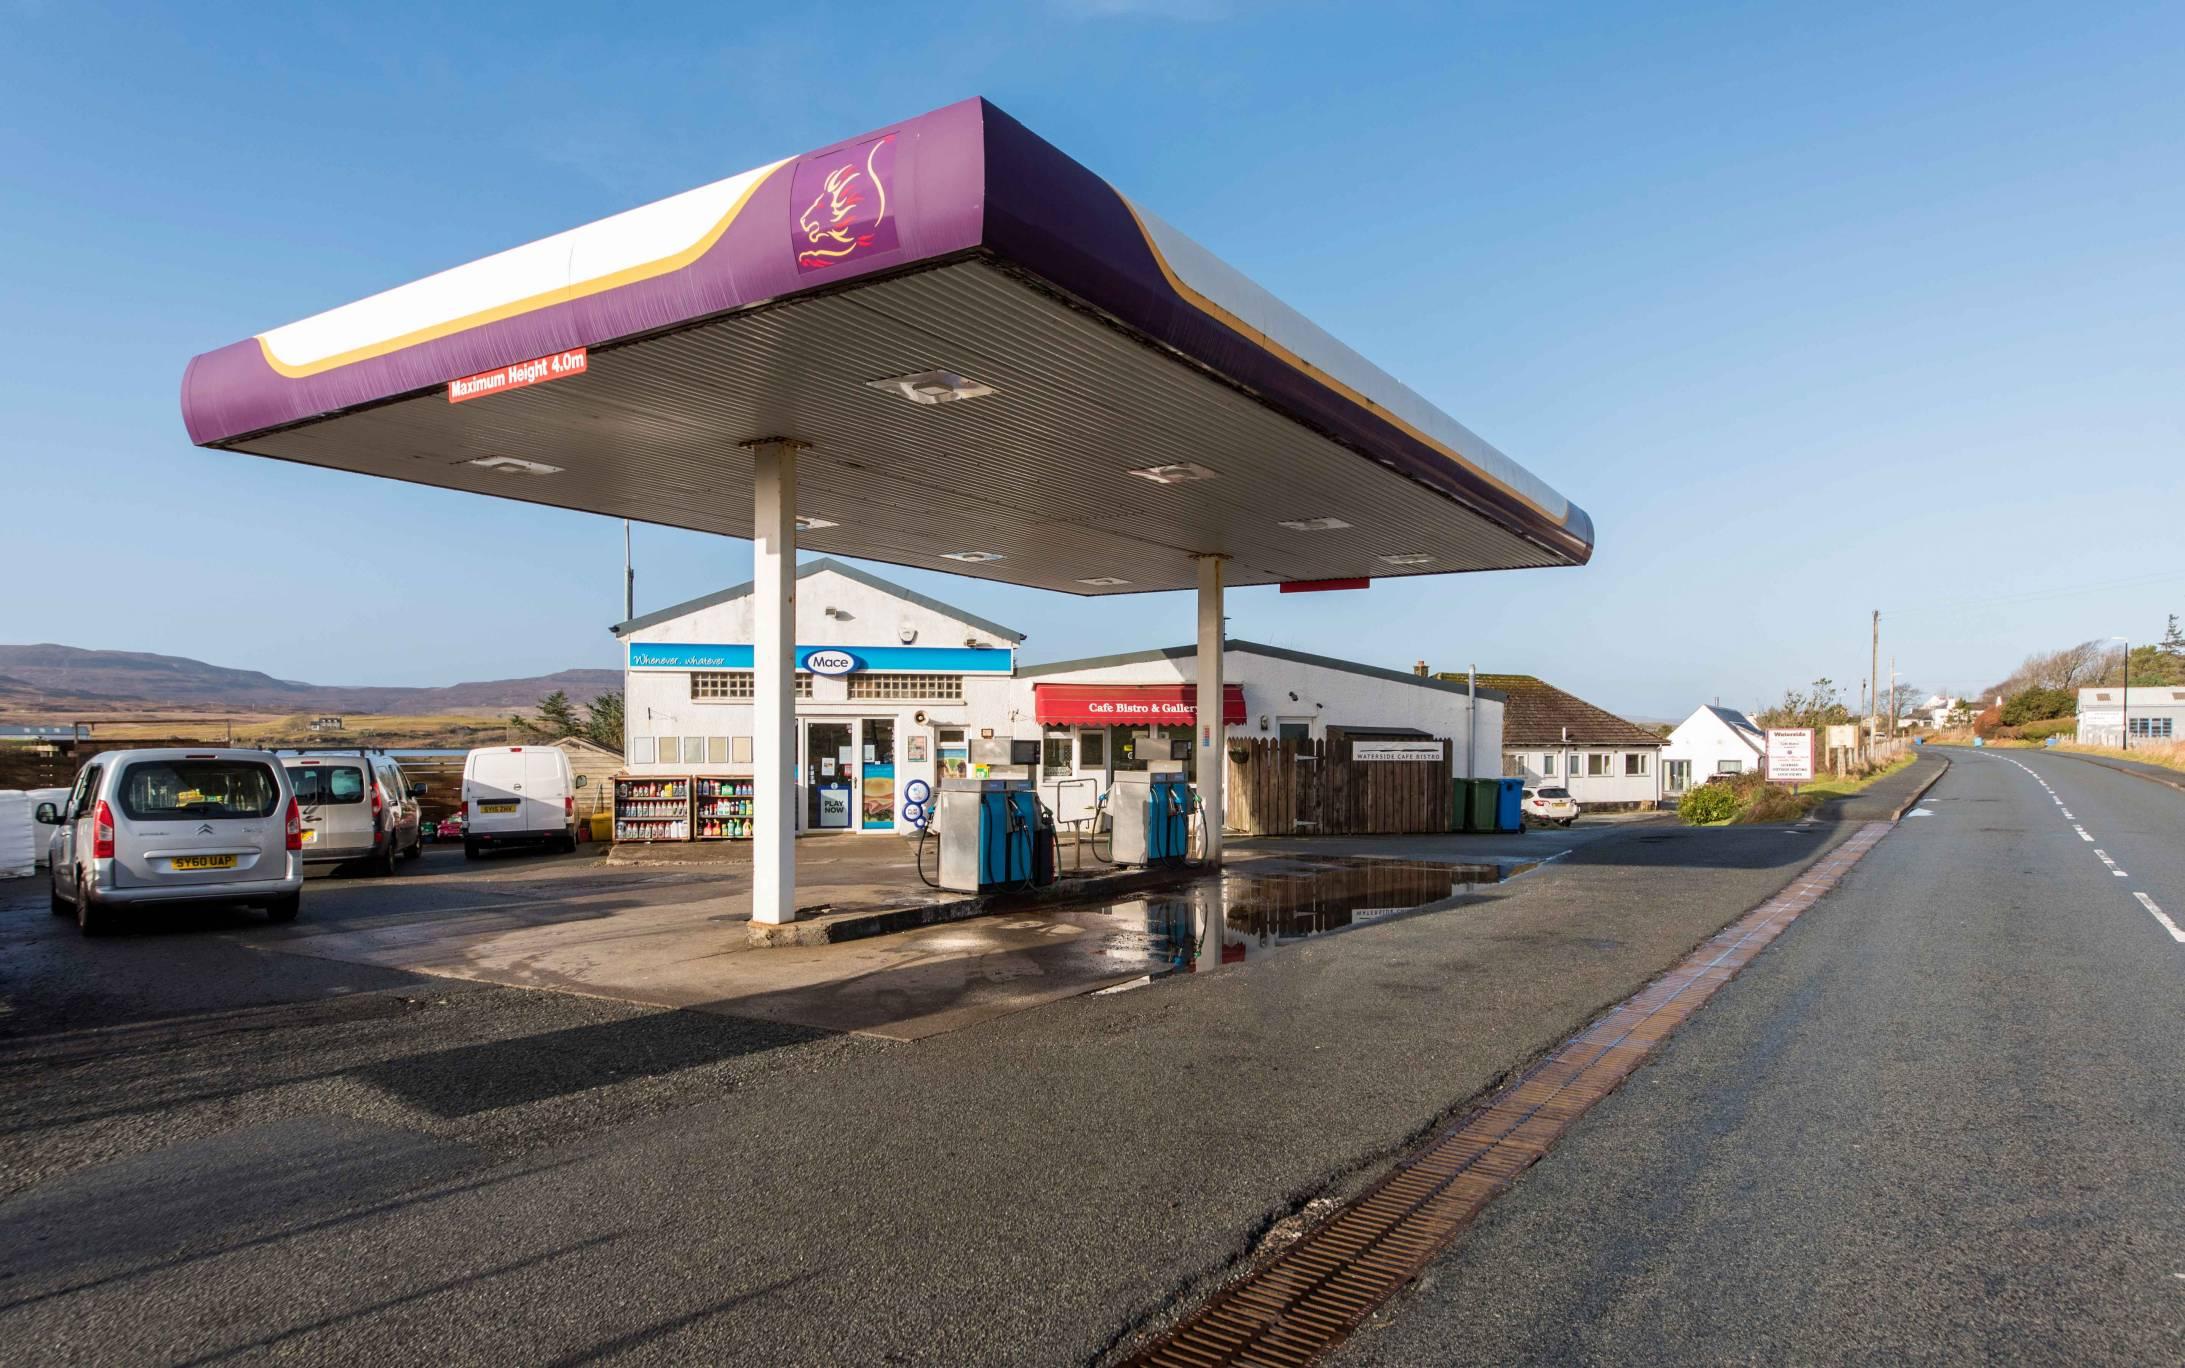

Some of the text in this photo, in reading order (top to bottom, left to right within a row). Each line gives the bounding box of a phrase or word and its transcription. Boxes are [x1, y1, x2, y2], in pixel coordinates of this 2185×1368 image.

[451, 352, 584, 398] Maximum Height 4.0m
[812, 656, 849, 668] Mace
[1116, 702, 1149, 713] Bistro
[1151, 702, 1160, 713] &
[176, 856, 232, 868] SY60 UAP
